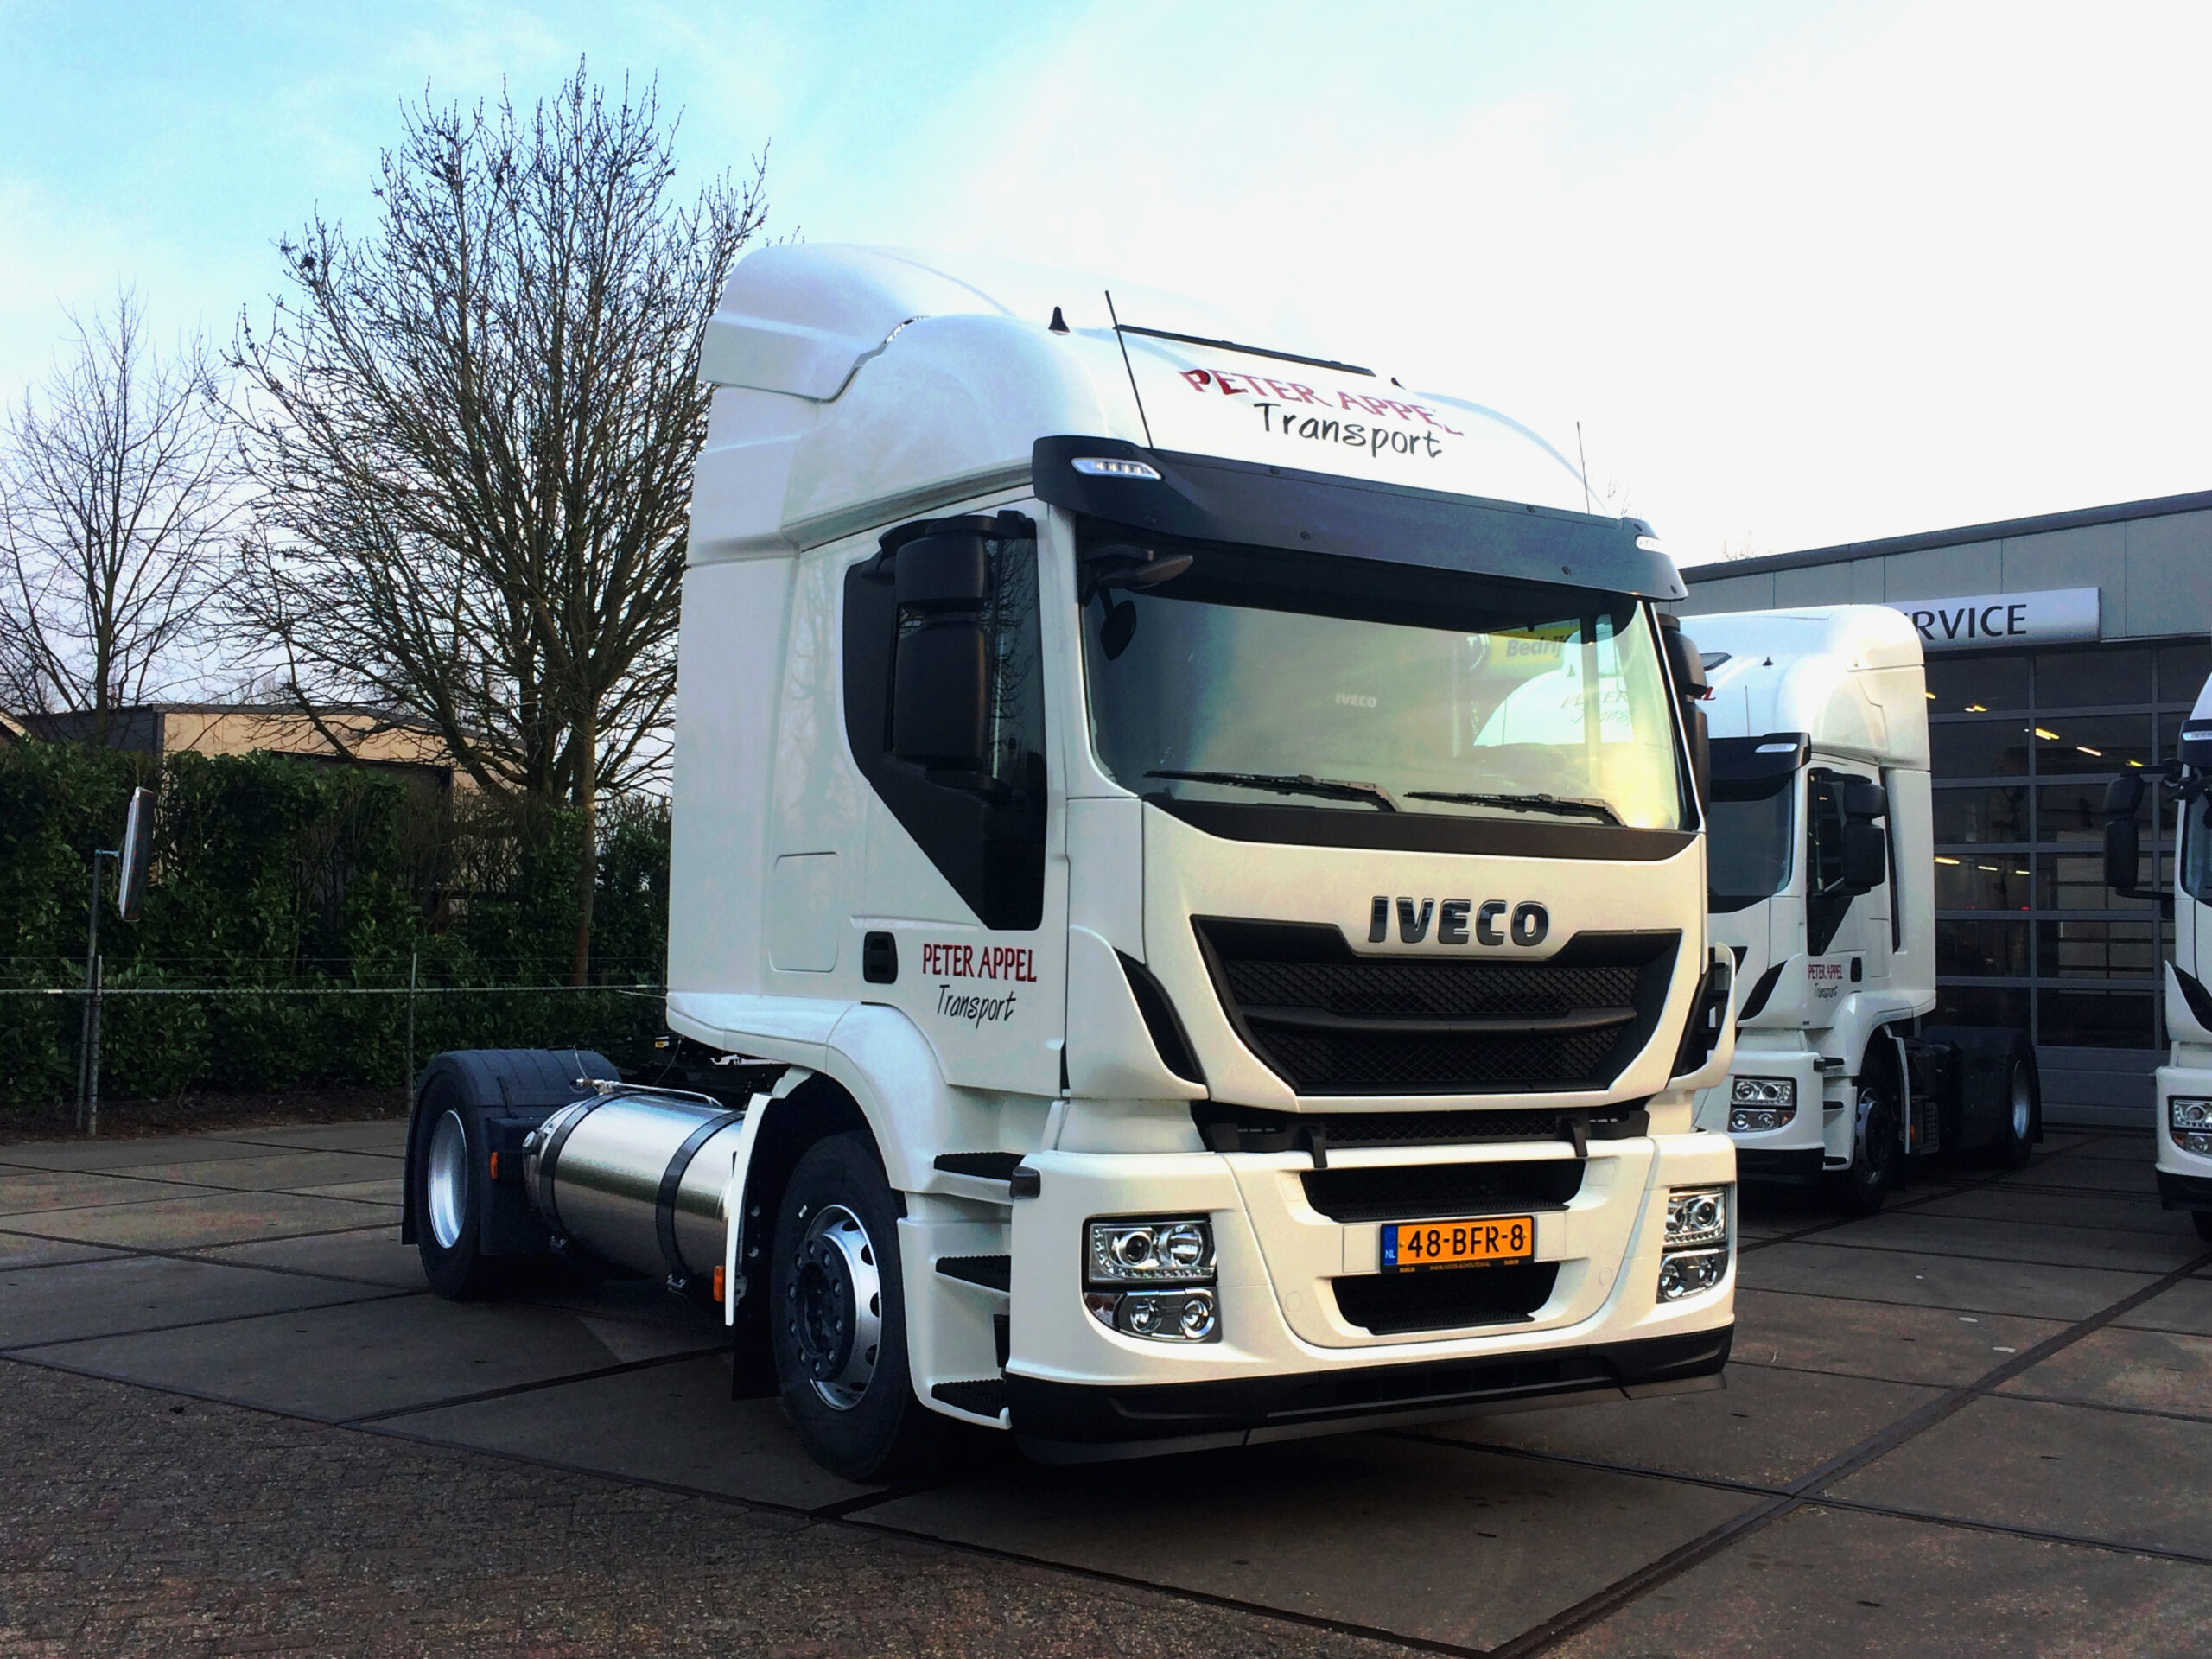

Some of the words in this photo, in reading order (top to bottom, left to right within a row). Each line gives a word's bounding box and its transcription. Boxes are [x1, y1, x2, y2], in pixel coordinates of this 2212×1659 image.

[1177, 369, 1334, 408] PETER
[1337, 391, 1465, 436] APPEL
[1253, 403, 1443, 459] Transport
[1904, 603, 2027, 640] RVICE
[1506, 634, 1571, 658] Bedrij
[1335, 693, 1377, 708] IVECO
[1368, 896, 1549, 947] IVECO
[922, 943, 975, 977] PETER
[977, 946, 1037, 982] APPEL
[1808, 964, 1825, 980] PETER
[1827, 964, 1843, 980] APPEL
[937, 984, 1017, 1029] Transport
[1385, 1249, 1395, 1259] NL
[1408, 1224, 1524, 1258] 48-BFR-8
